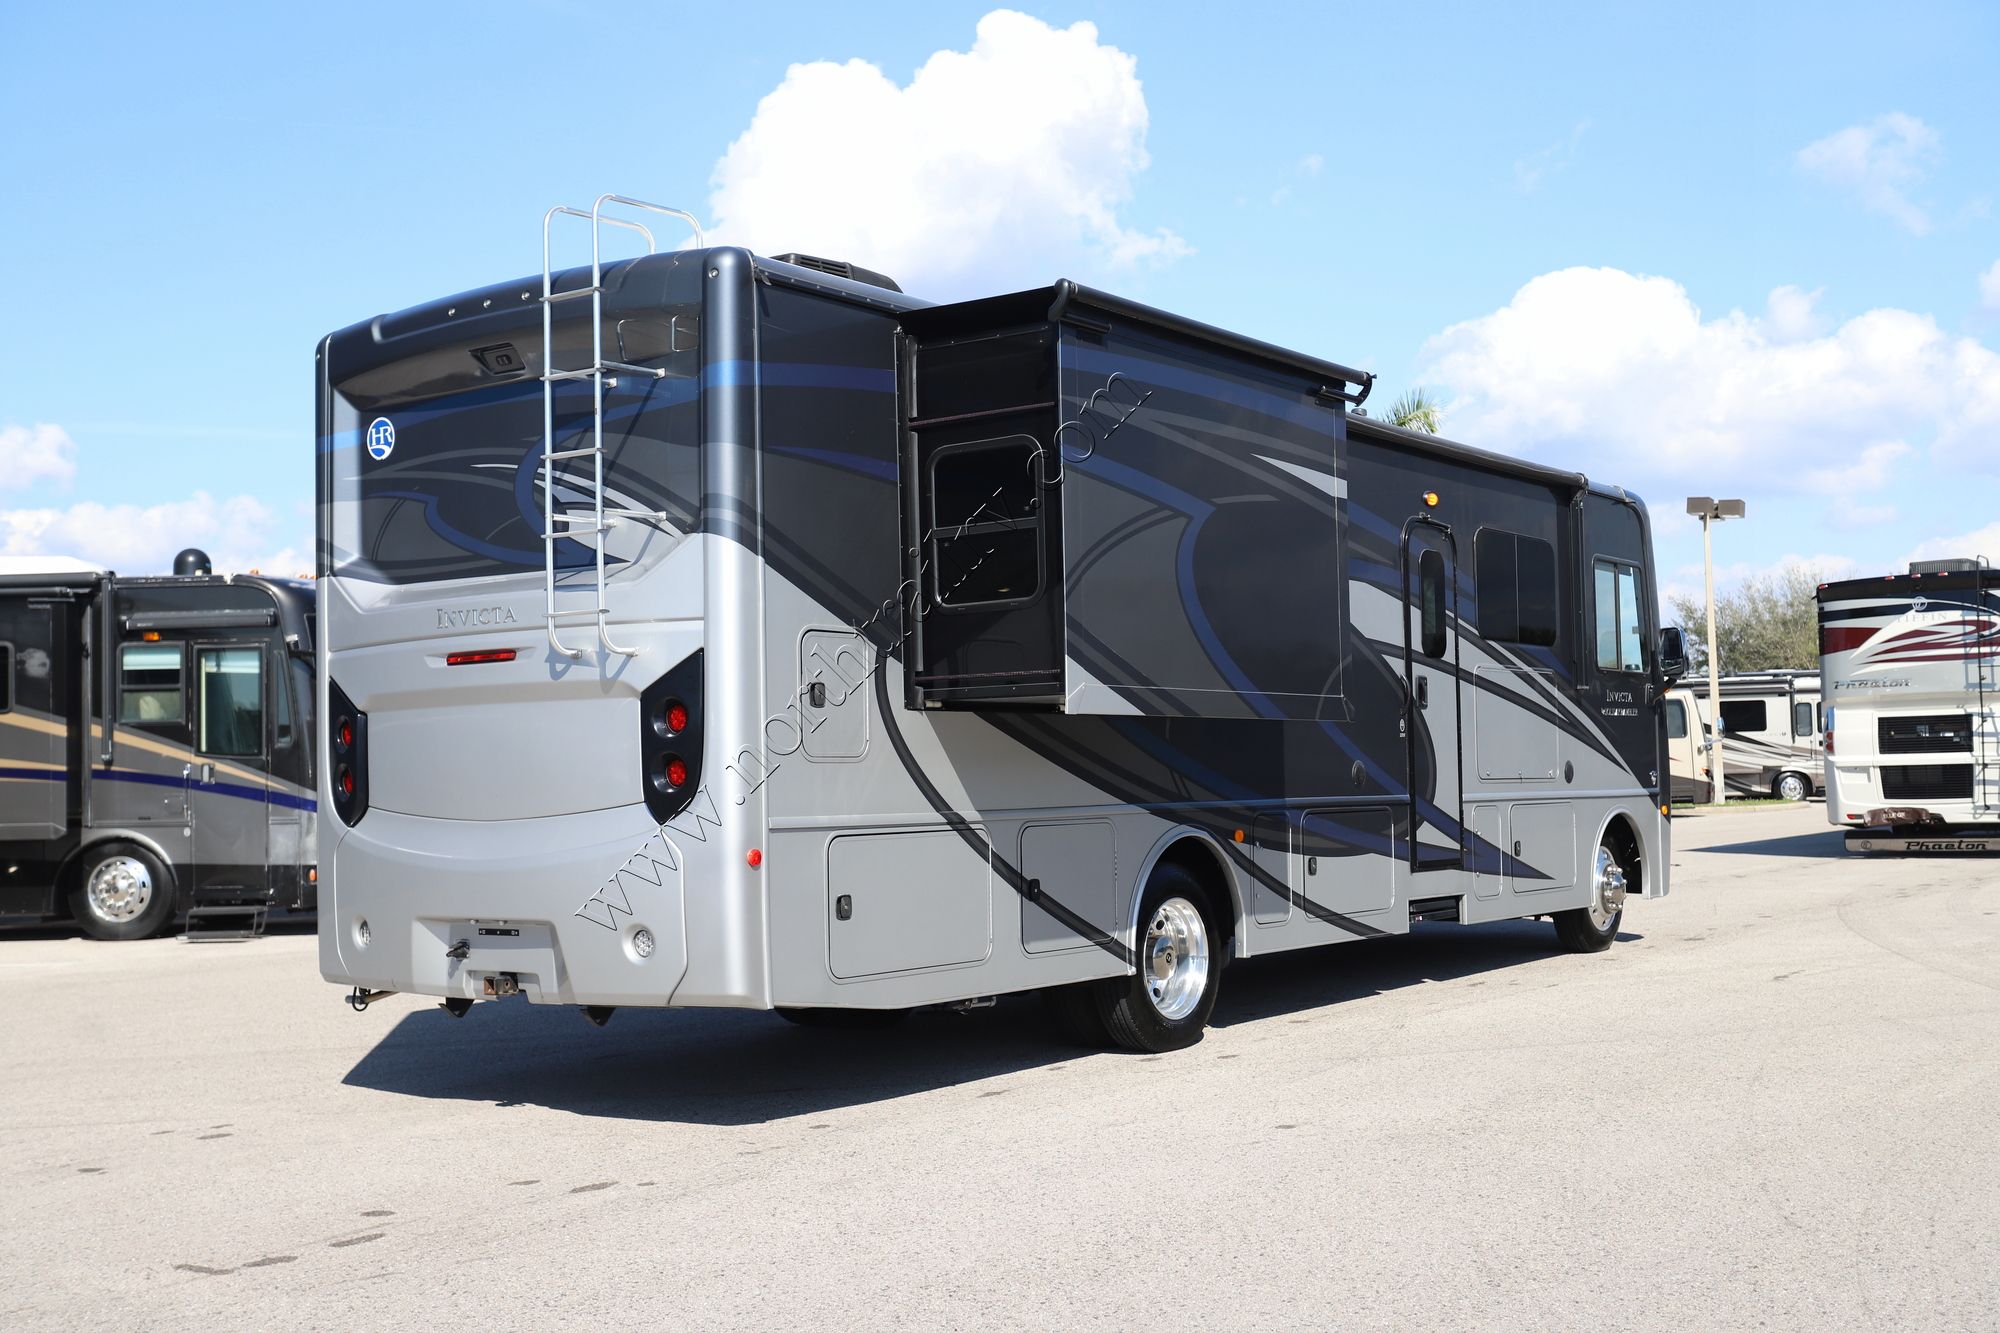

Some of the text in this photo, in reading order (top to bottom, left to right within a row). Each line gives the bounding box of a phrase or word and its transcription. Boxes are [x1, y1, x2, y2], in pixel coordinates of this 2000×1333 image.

[371, 425, 393, 447] HR
[436, 605, 517, 630] INVICTA
[1606, 689, 1633, 703] INVICTA
[1905, 840, 1989, 851] Phaeton
